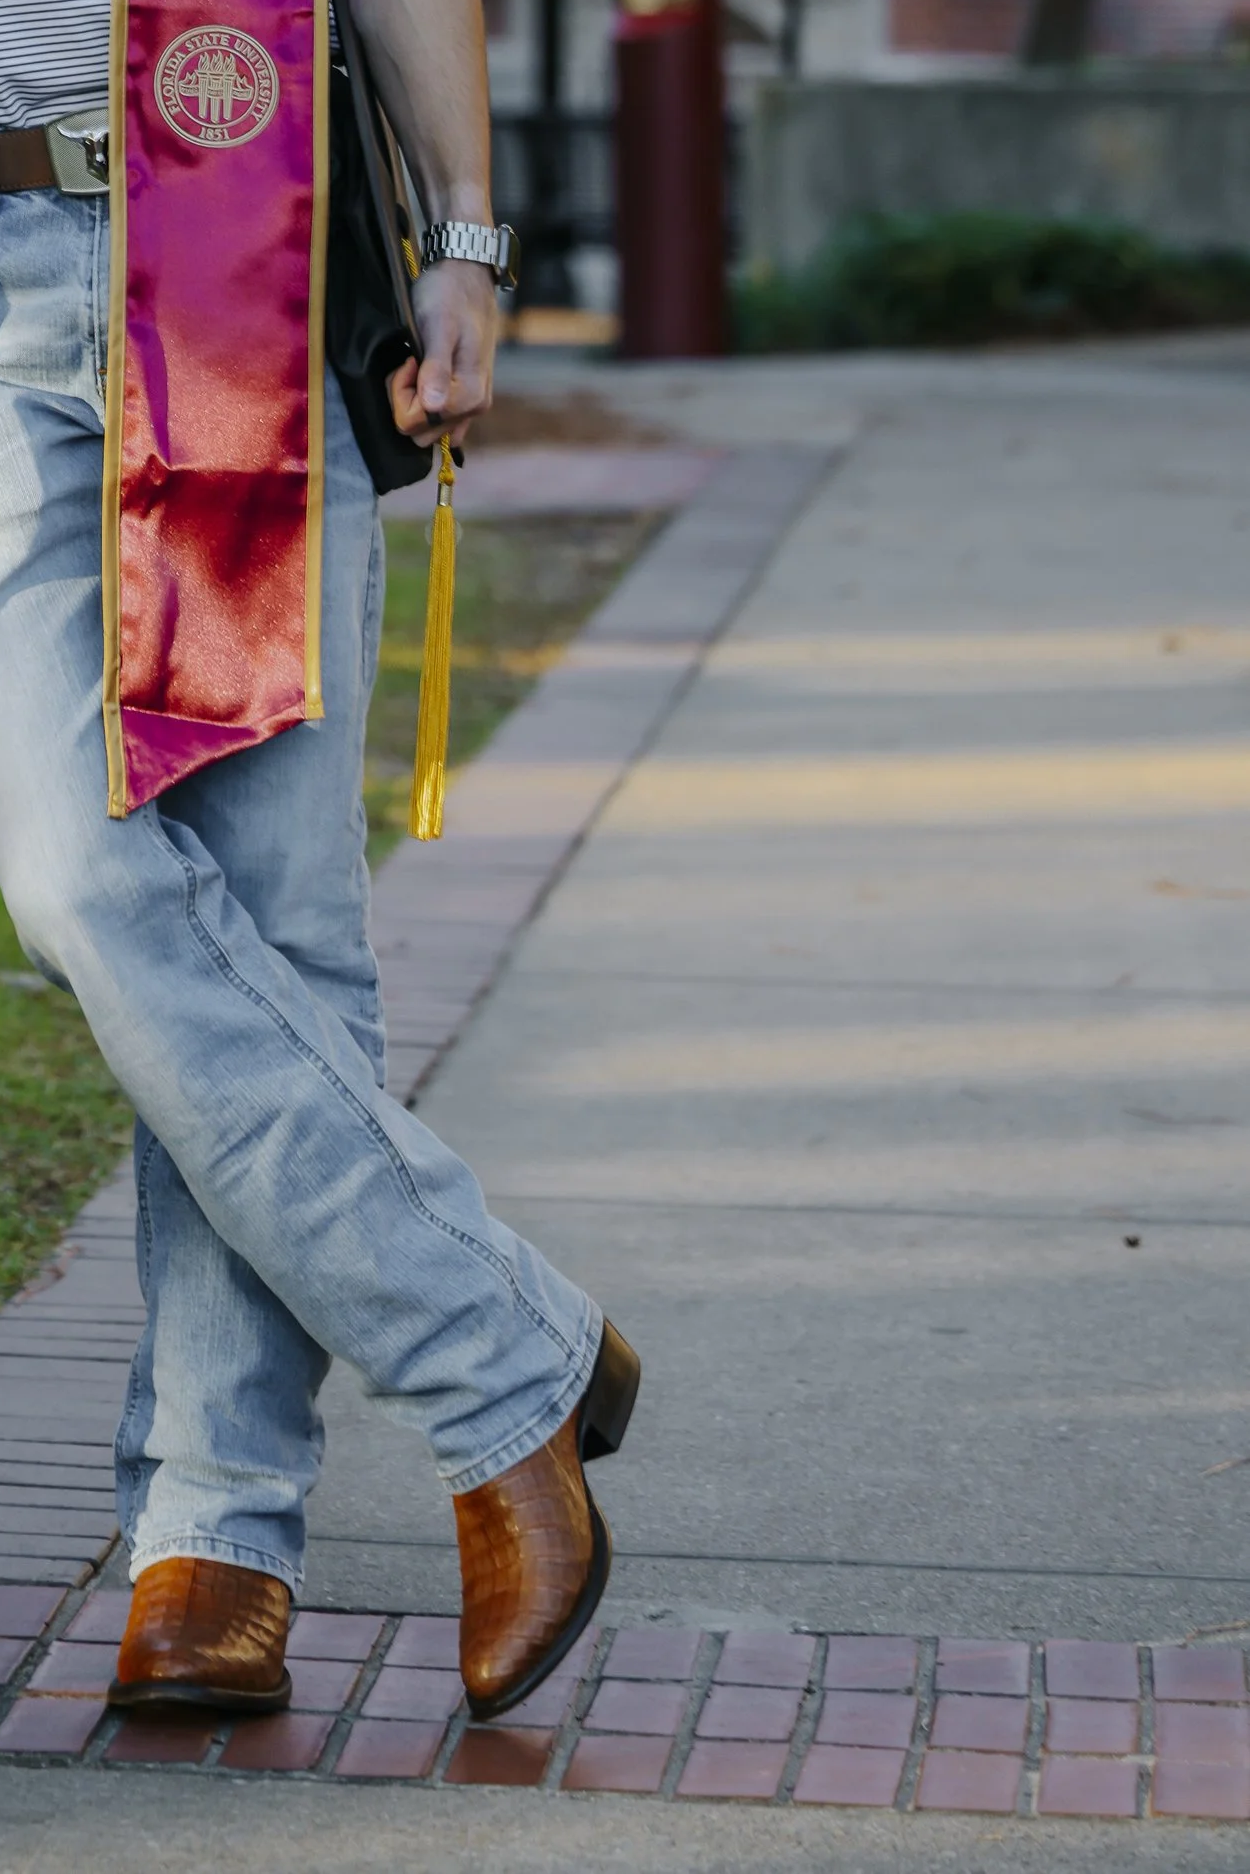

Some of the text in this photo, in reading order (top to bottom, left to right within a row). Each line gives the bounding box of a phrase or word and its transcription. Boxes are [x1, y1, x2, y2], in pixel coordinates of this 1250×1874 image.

[162, 33, 272, 122] FLORIDA STATE UNIVERSITY
[198, 126, 231, 141] 1851
